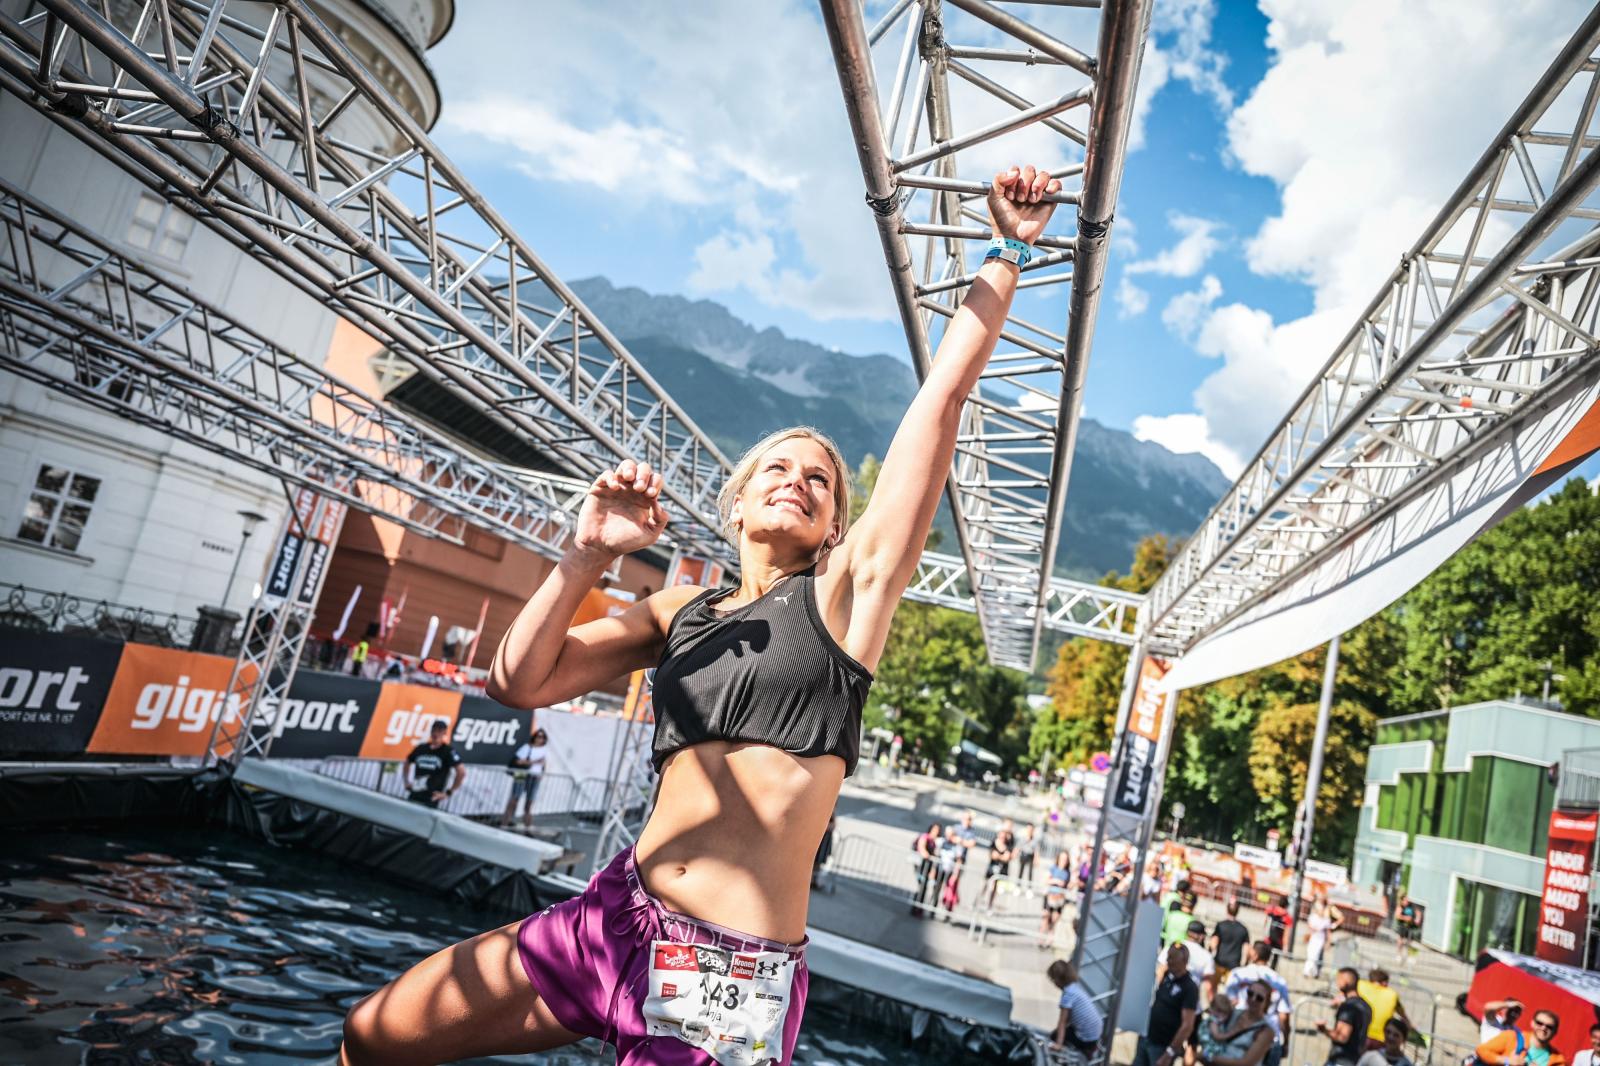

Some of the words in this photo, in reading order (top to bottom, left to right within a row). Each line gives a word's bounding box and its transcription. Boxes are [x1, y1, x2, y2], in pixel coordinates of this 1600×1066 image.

[274, 535, 298, 591] sport
[303, 545, 327, 598] sport
[131, 675, 242, 732] giga
[252, 697, 360, 738] sport
[384, 704, 452, 745] gig
[453, 718, 520, 750] sport
[1549, 850, 1585, 872] UNDER
[1543, 904, 1565, 927] YOU
[1541, 924, 1576, 951] BETTER
[732, 966, 754, 977] Zeitung
[734, 957, 755, 969] Kronen
[700, 979, 739, 1010] 143
